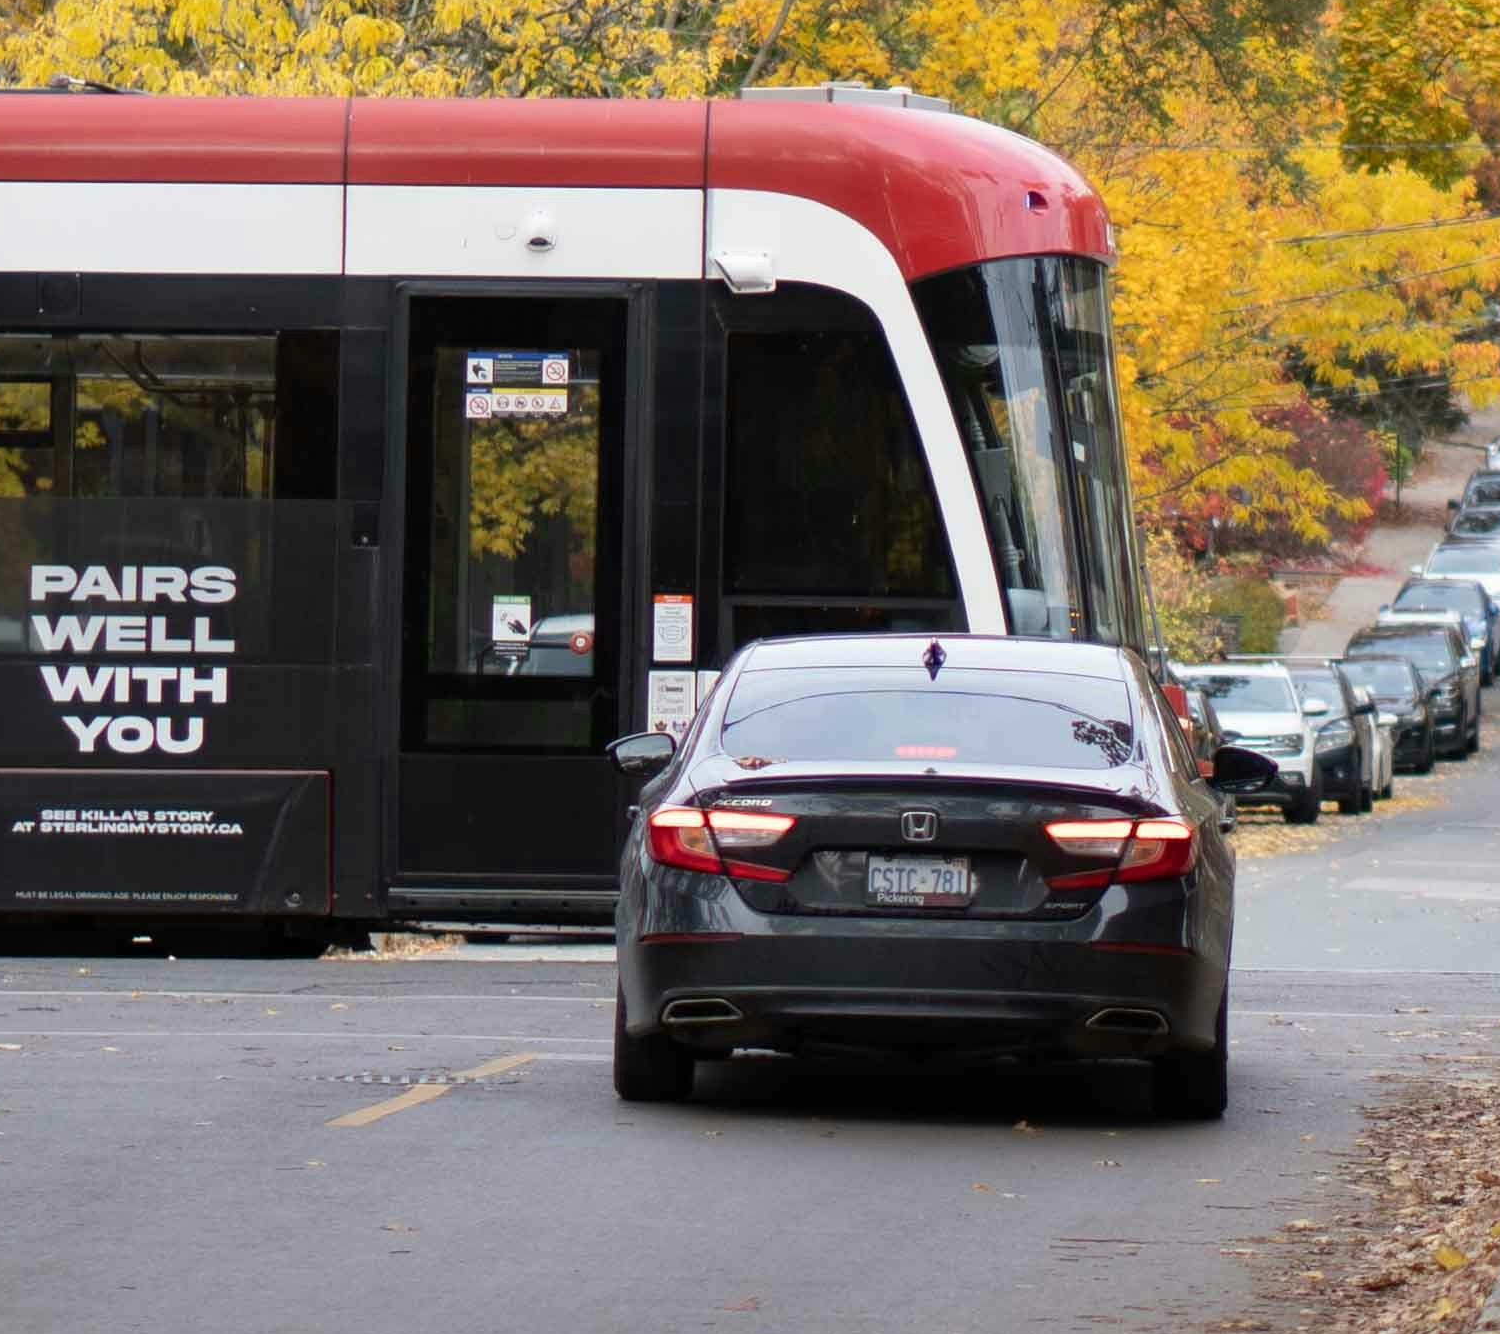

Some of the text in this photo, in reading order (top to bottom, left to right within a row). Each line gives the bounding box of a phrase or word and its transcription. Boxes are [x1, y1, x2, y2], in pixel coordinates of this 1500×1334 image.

[31, 565, 237, 603] PAIRS
[31, 615, 236, 653] WELL
[39, 665, 228, 703] WITH
[61, 716, 204, 754] YOU
[712, 798, 772, 807] ACCORD
[41, 809, 213, 822] SEE KILLA'S STORY
[12, 821, 243, 834] AT STERLINGMYSTORY.CA
[49, 891, 74, 900] LEGAL
[132, 892, 161, 900] PLEASE
[162, 892, 187, 900] ENJOY
[877, 892, 925, 906] Pickering
